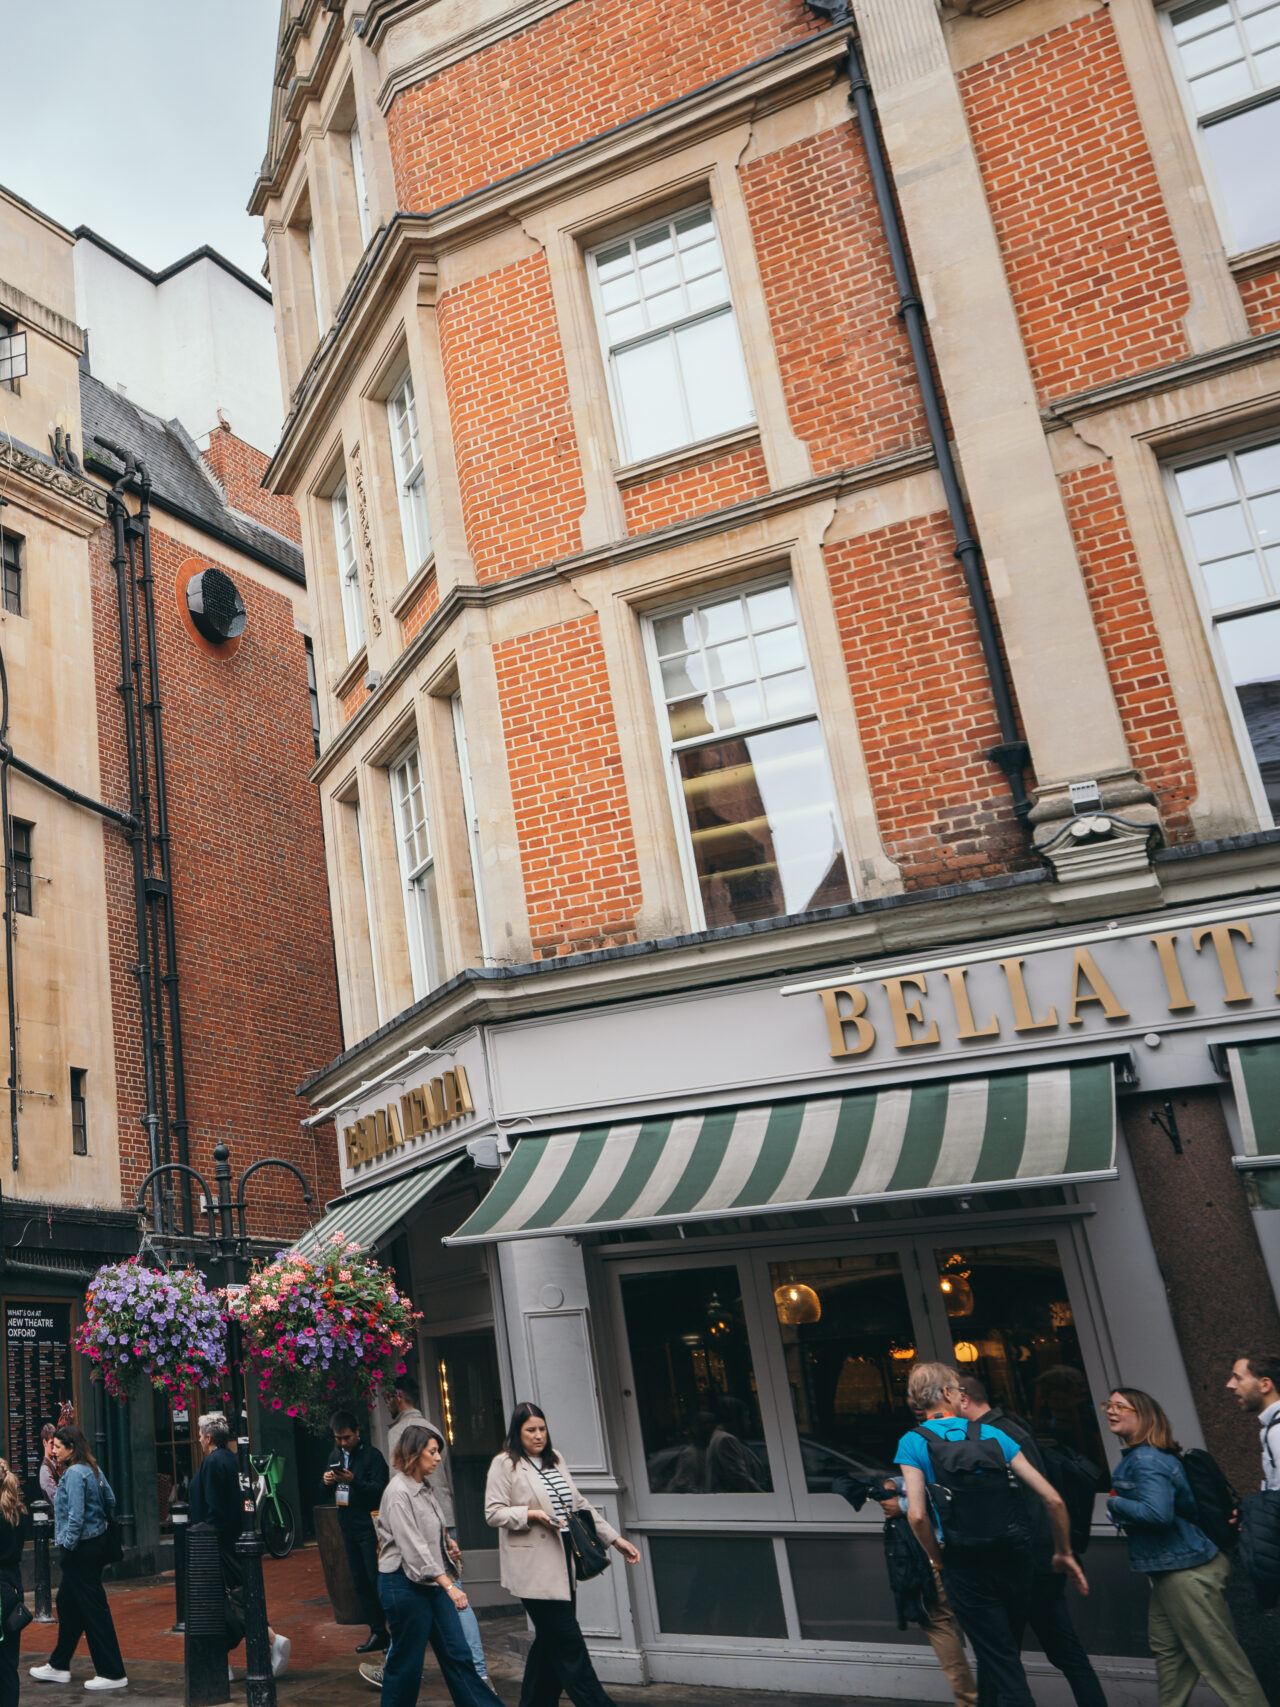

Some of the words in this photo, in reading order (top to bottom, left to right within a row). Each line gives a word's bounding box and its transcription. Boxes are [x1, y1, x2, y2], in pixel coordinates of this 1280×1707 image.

[818, 947, 1129, 1057] BELLA
[1149, 922, 1280, 1010] IT
[8, 1318, 23, 1327] NEW
[24, 1318, 54, 1327] THEATRE
[8, 1329, 36, 1337] OXFORD
